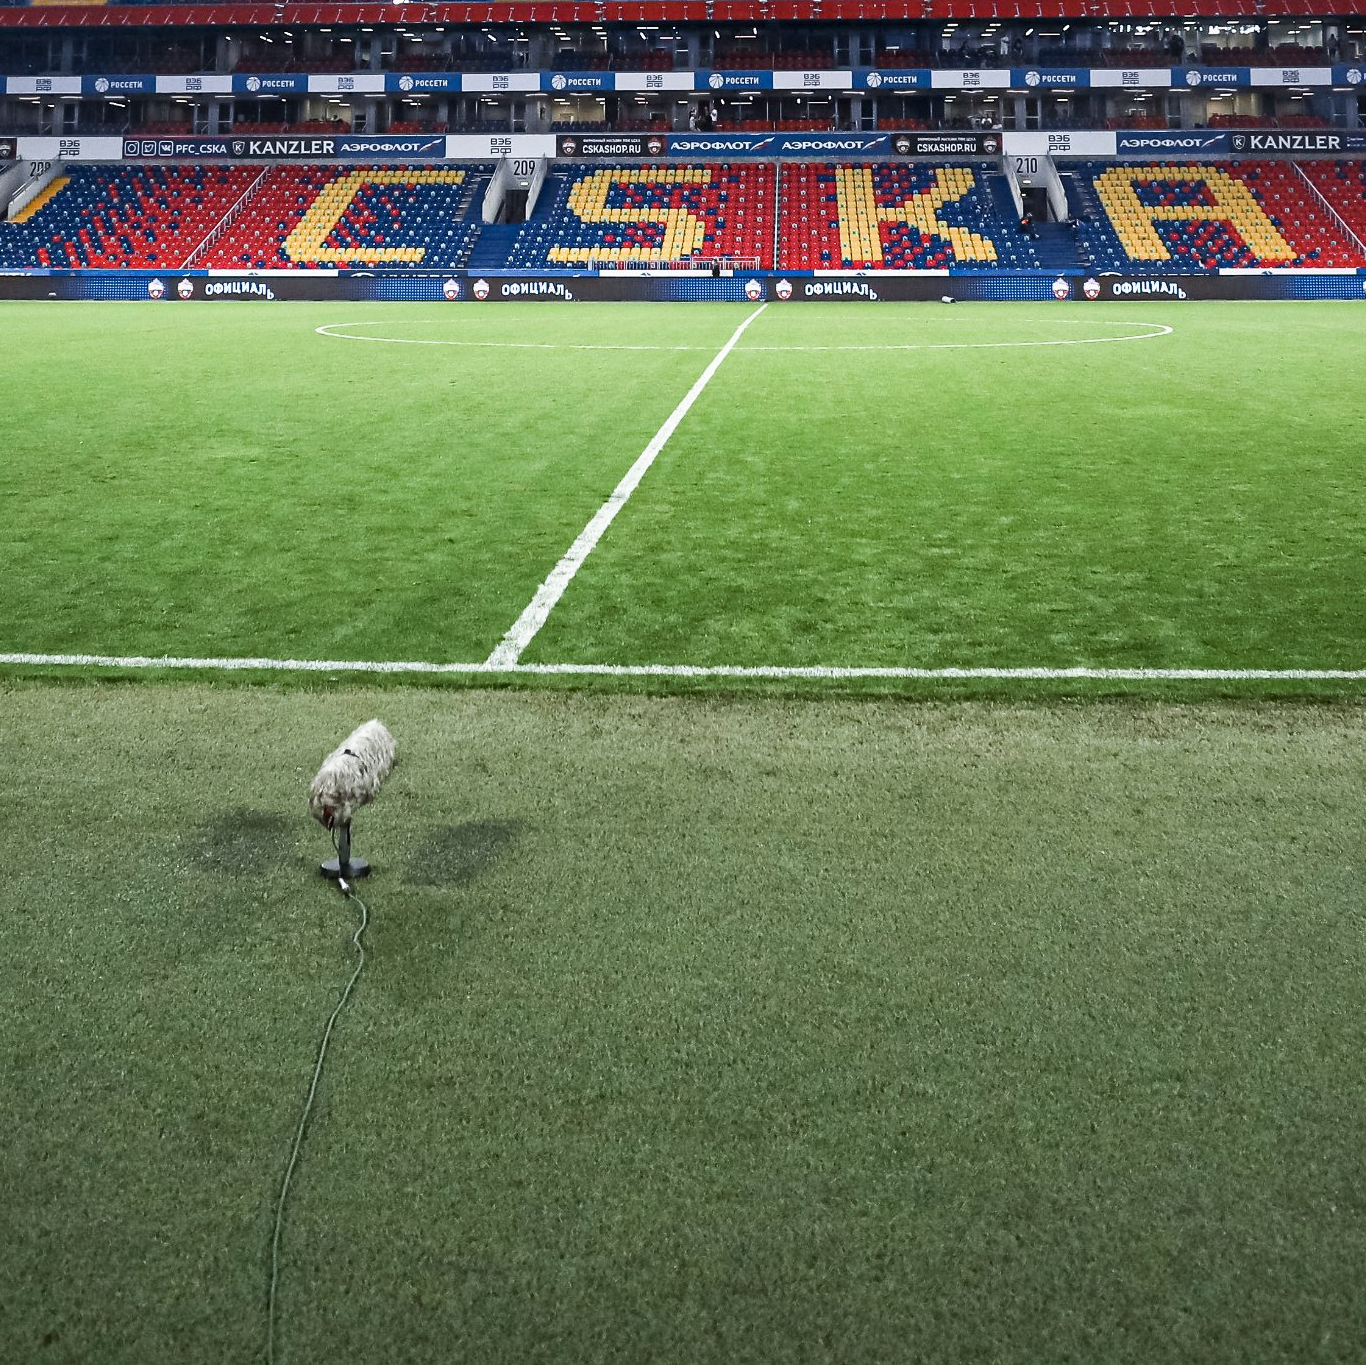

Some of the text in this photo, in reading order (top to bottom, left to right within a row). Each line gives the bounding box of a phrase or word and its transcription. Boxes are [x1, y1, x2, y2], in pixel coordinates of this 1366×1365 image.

[568, 78, 601, 86] РОССЕТИ
[884, 76, 917, 84] РОССЕТИ
[1203, 74, 1237, 82] РОССЕТИ
[110, 81, 143, 89] РОССЕТИ
[262, 79, 294, 88] РОССЕТИ
[415, 79, 448, 87] РОССЕТИ
[1049, 134, 1069, 142] ВЭБ
[249, 141, 335, 154] KANZLER
[341, 143, 421, 152] АЭРОФЛОТ
[671, 142, 752, 150] АЭРОФЛОТ
[782, 141, 864, 150] АЭРОФЛОТ
[1120, 139, 1202, 148] АЭРОФЛОТ
[1250, 136, 1341, 150] KANZLER
[175, 144, 227, 154] PFC_CSKA
[583, 145, 640, 153] CSKASHOP.RU
[917, 144, 976, 152] CSKASHOP.RU
[514, 161, 535, 176] 209
[1016, 158, 1037, 173] 210
[205, 282, 275, 300] ОФИЦИАЛЬ
[502, 282, 572, 300] ОФИЦИАЛЬ
[805, 282, 877, 300] ОФИЦИАЛЬ
[1113, 282, 1186, 299] ОФИЦИАЛЬ
